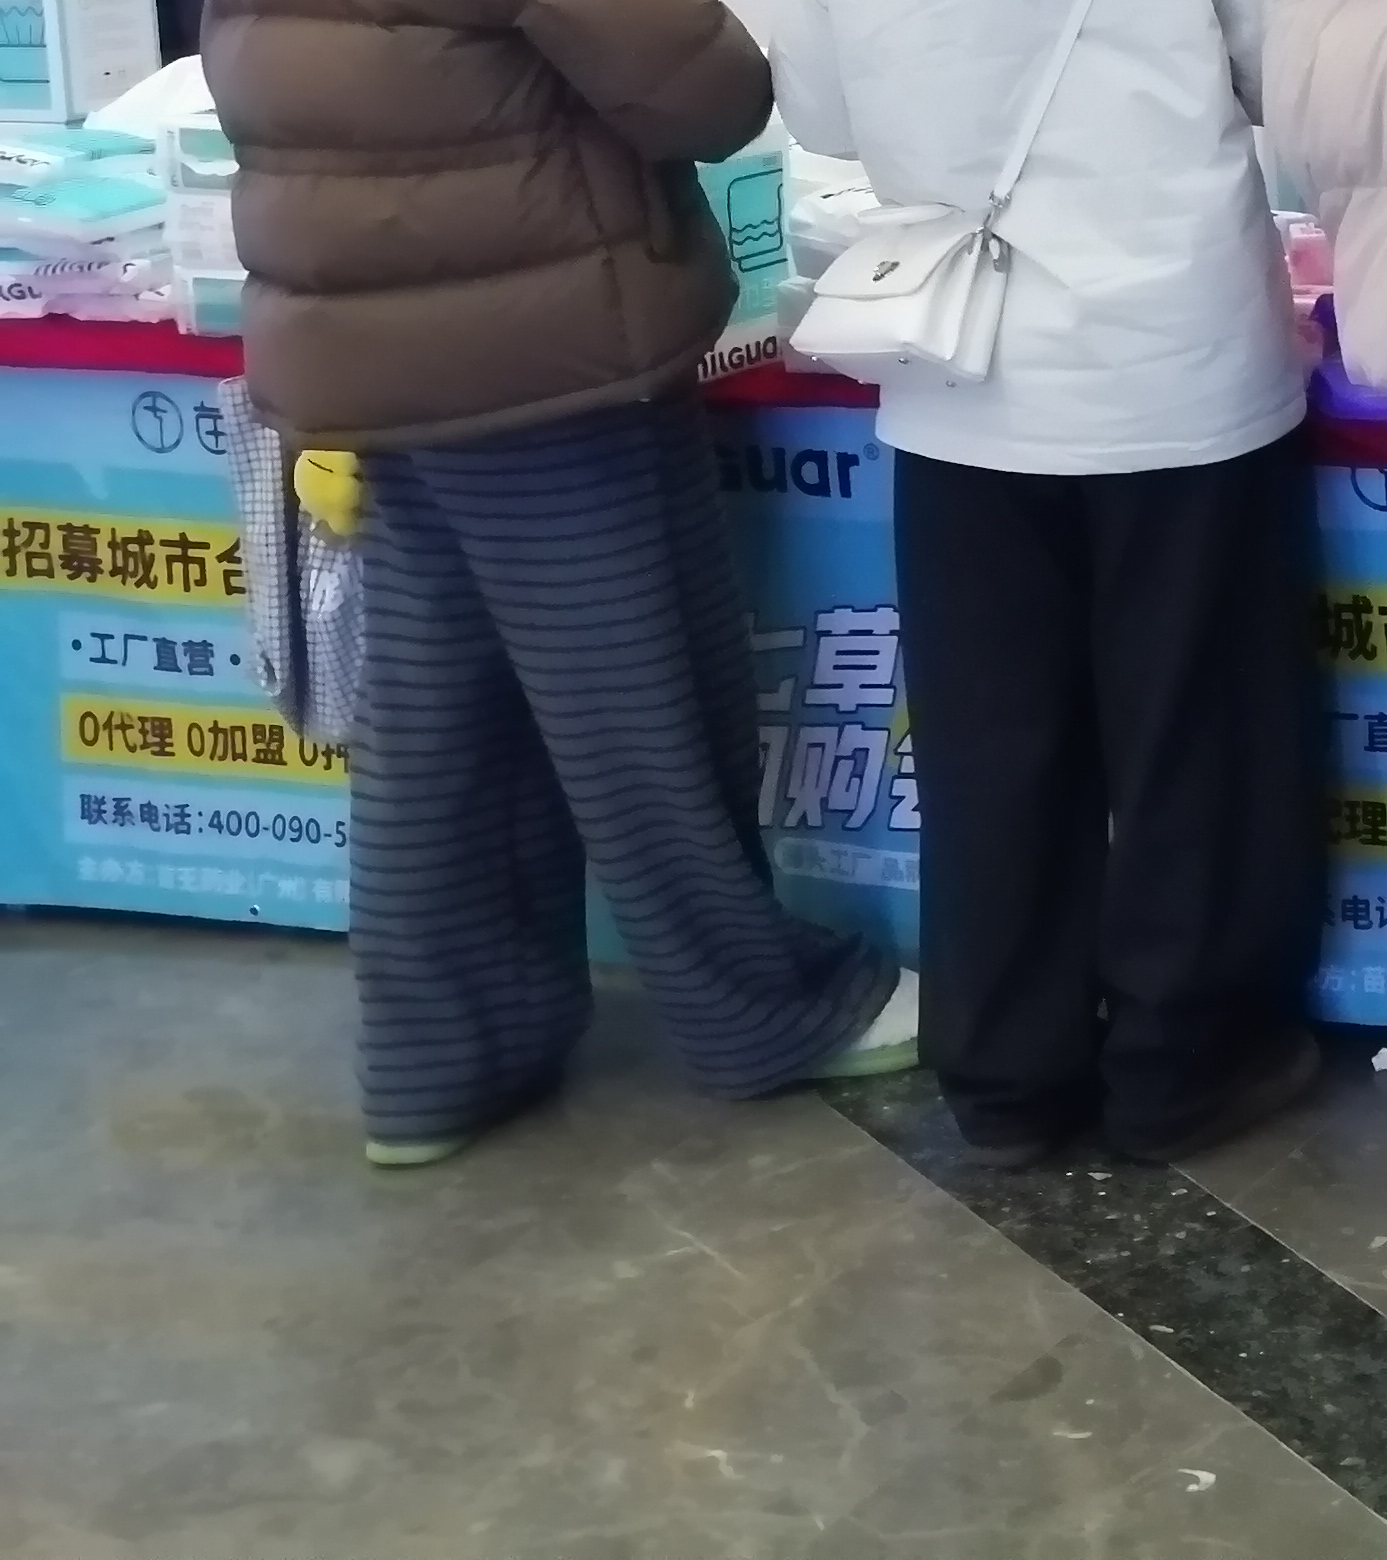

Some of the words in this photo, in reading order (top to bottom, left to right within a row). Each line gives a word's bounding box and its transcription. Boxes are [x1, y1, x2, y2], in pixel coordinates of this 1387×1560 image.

[89, 632, 215, 677] 工厂直营
[79, 709, 176, 758] 0代理
[187, 720, 287, 767] 0加盟
